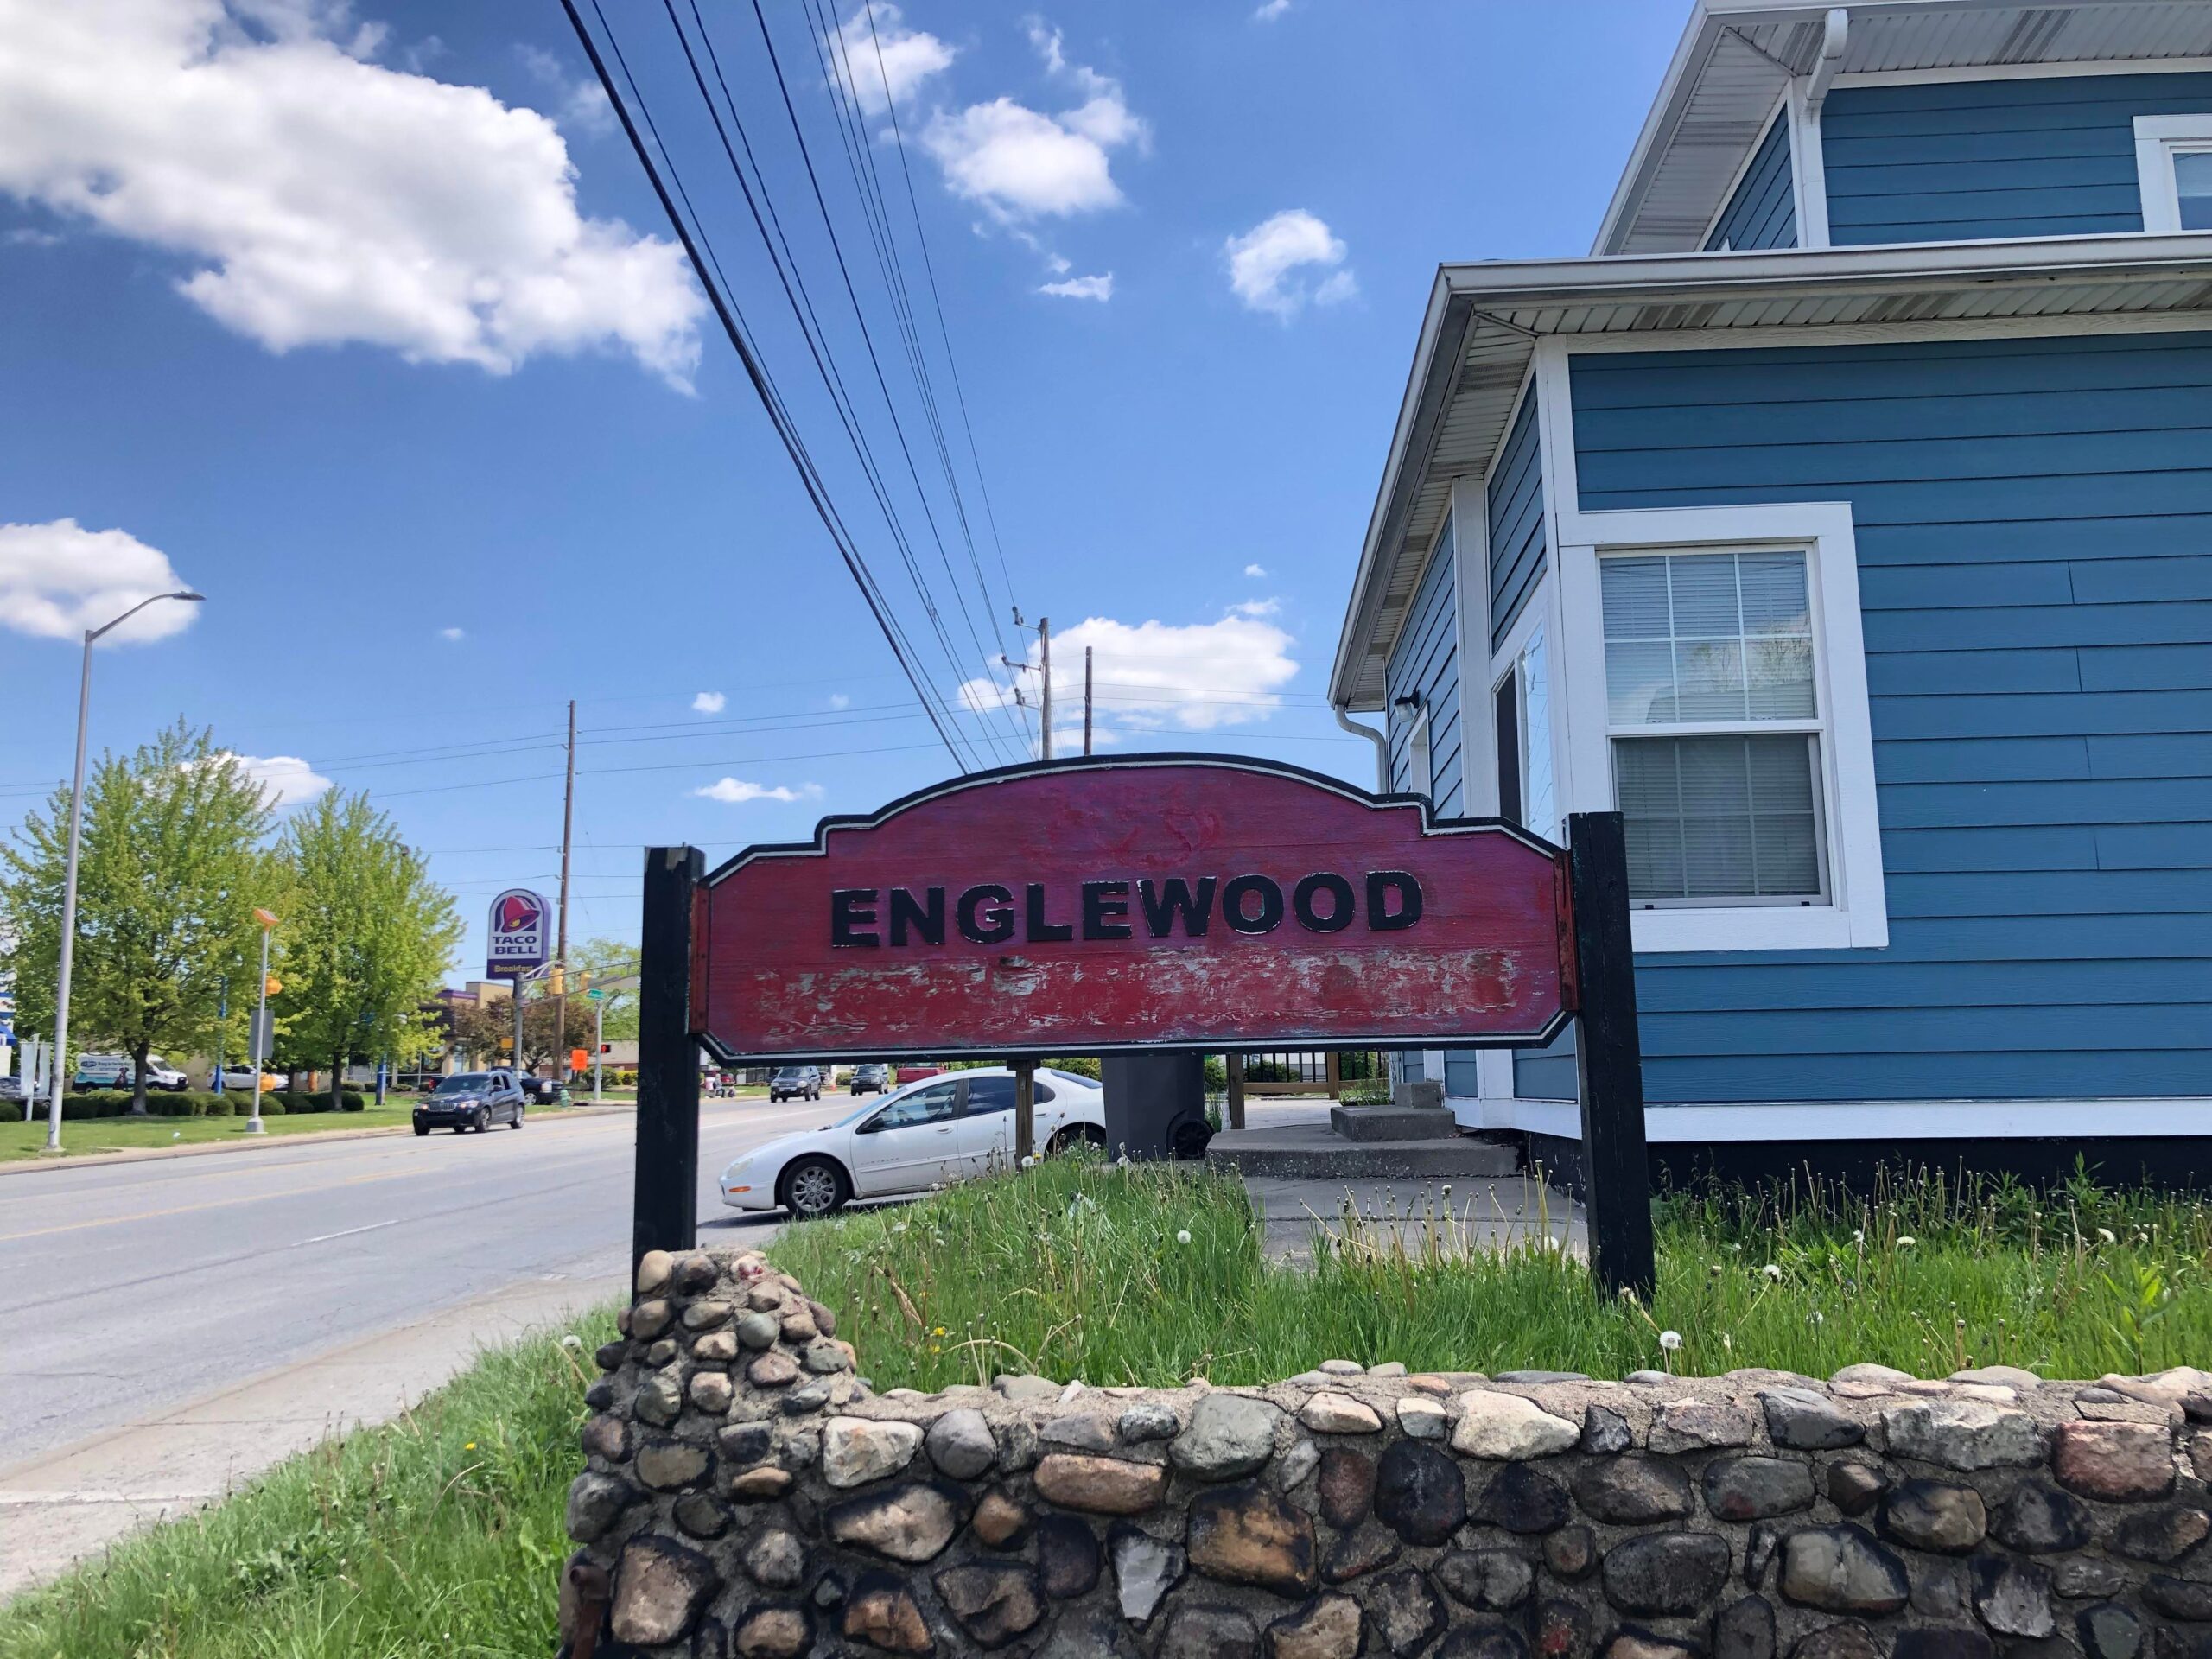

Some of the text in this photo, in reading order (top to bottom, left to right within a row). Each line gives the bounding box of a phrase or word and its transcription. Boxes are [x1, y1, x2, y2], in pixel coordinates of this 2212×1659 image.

[832, 870, 1423, 947] ENGLEWOOD
[493, 936, 537, 944] TACO
[494, 946, 537, 955] BELL
